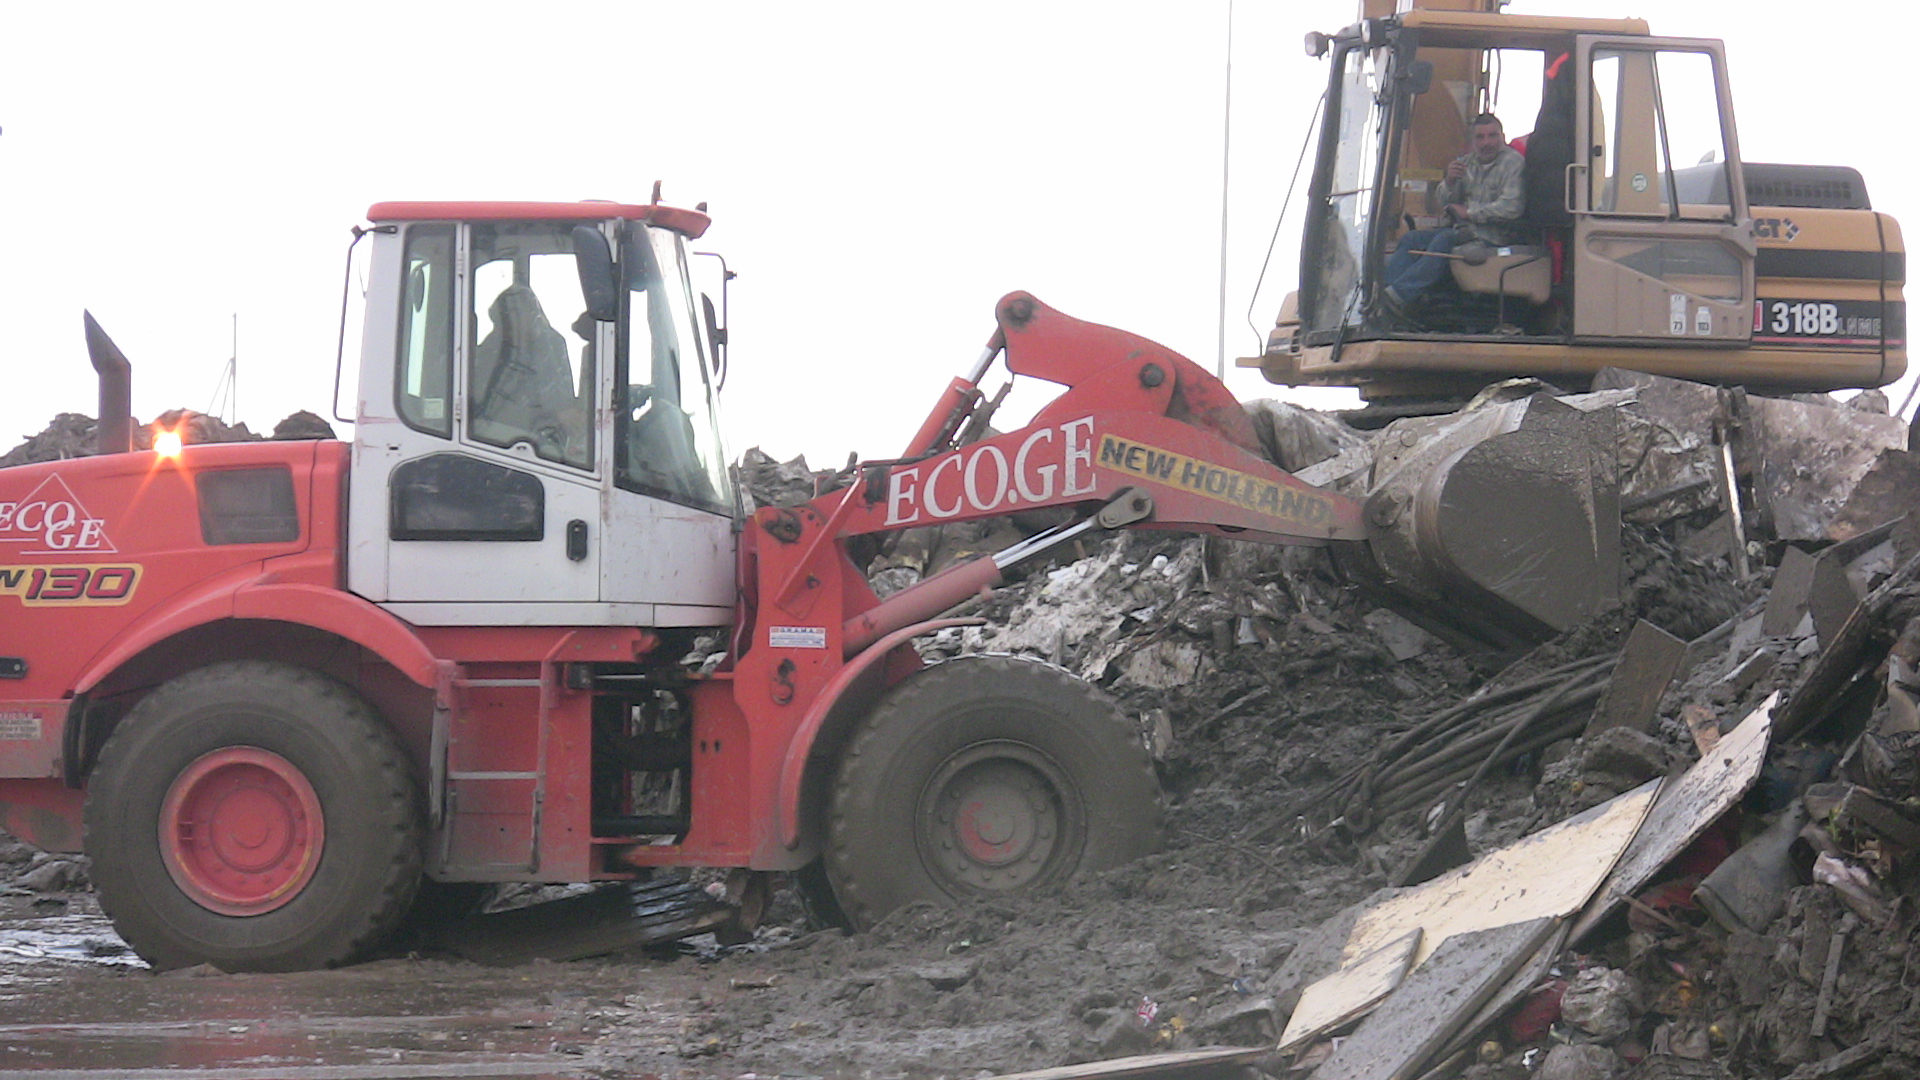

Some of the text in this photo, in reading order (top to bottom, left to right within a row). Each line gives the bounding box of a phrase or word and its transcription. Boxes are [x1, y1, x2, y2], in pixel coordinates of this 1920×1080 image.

[1771, 302, 1838, 334] 318B
[883, 415, 1097, 526] ECO.GE
[1101, 437, 1329, 523] NEW HOLLAND
[0, 501, 76, 532] ECO
[45, 519, 105, 549] GE
